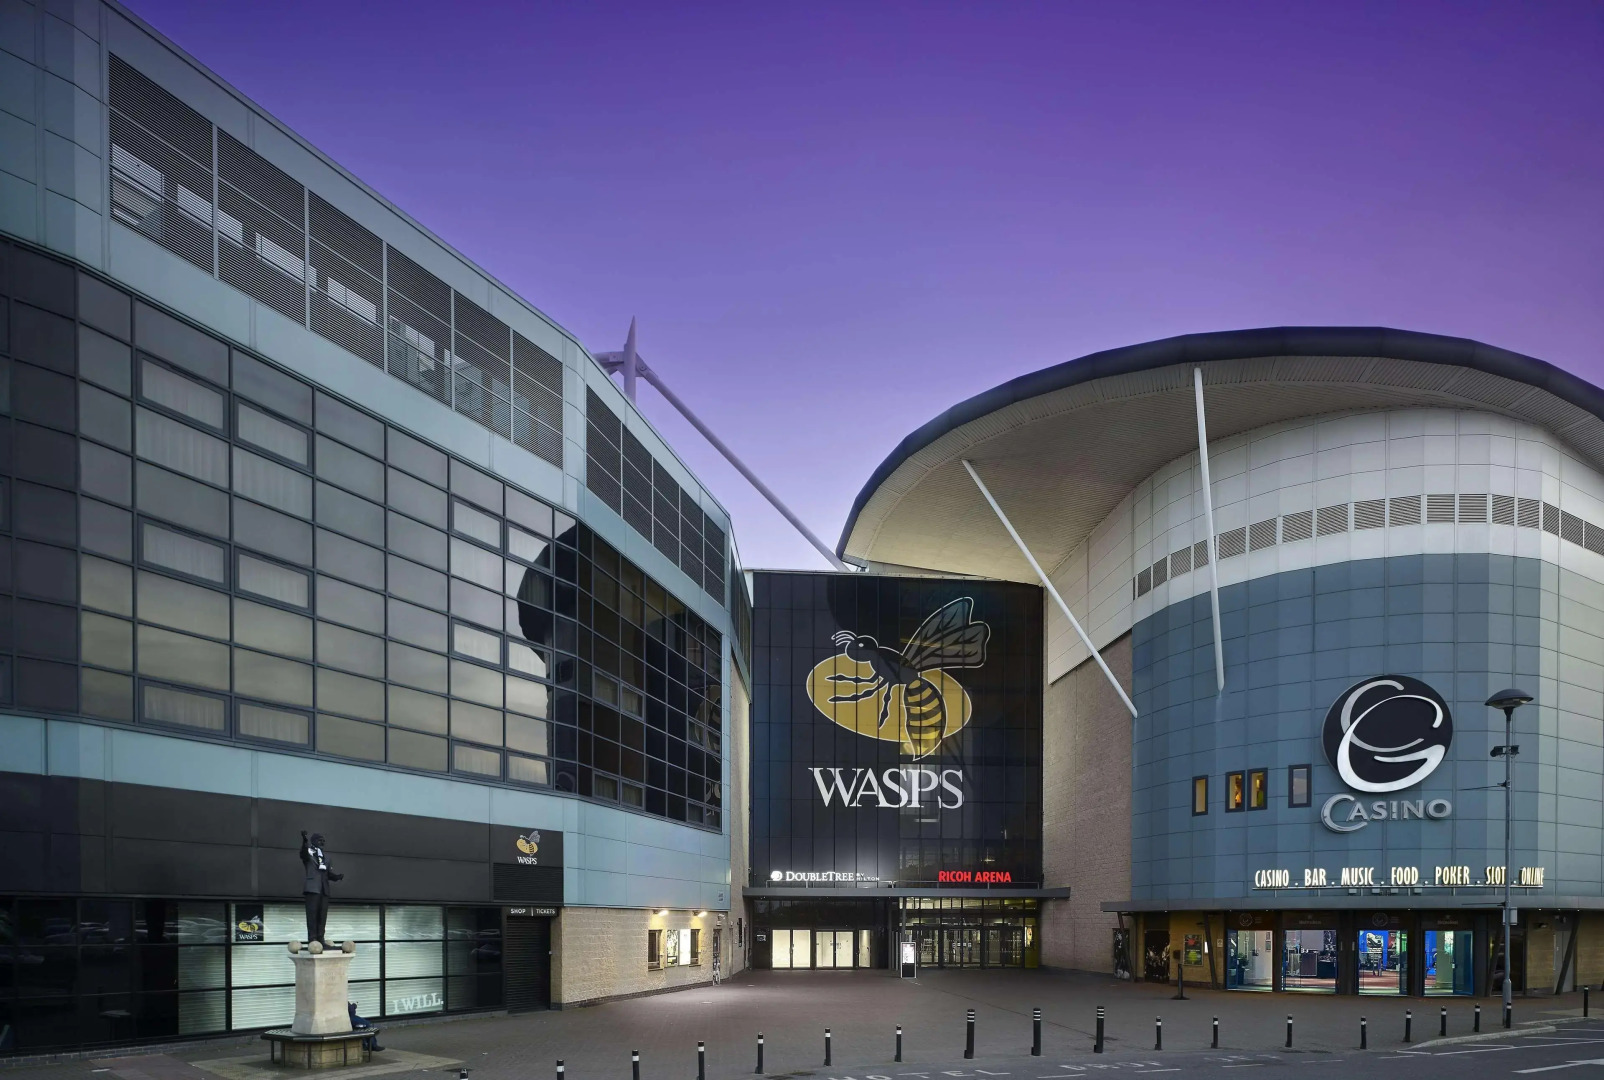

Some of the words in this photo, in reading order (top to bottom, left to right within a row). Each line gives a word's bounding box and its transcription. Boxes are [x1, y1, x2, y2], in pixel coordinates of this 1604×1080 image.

[807, 767, 965, 809] WASPS
[1321, 793, 1452, 834] CASINO
[516, 856, 538, 865] WASPS
[938, 871, 972, 882] RICOH
[974, 871, 1012, 883] ARENA
[1254, 869, 1290, 888] CASINO
[1304, 868, 1327, 887] BAR
[1340, 867, 1374, 886] MUSIC
[1391, 866, 1419, 885] FOOD
[1435, 866, 1470, 885] POKER
[1520, 867, 1545, 885] ONLINE
[393, 999, 400, 1014] I
